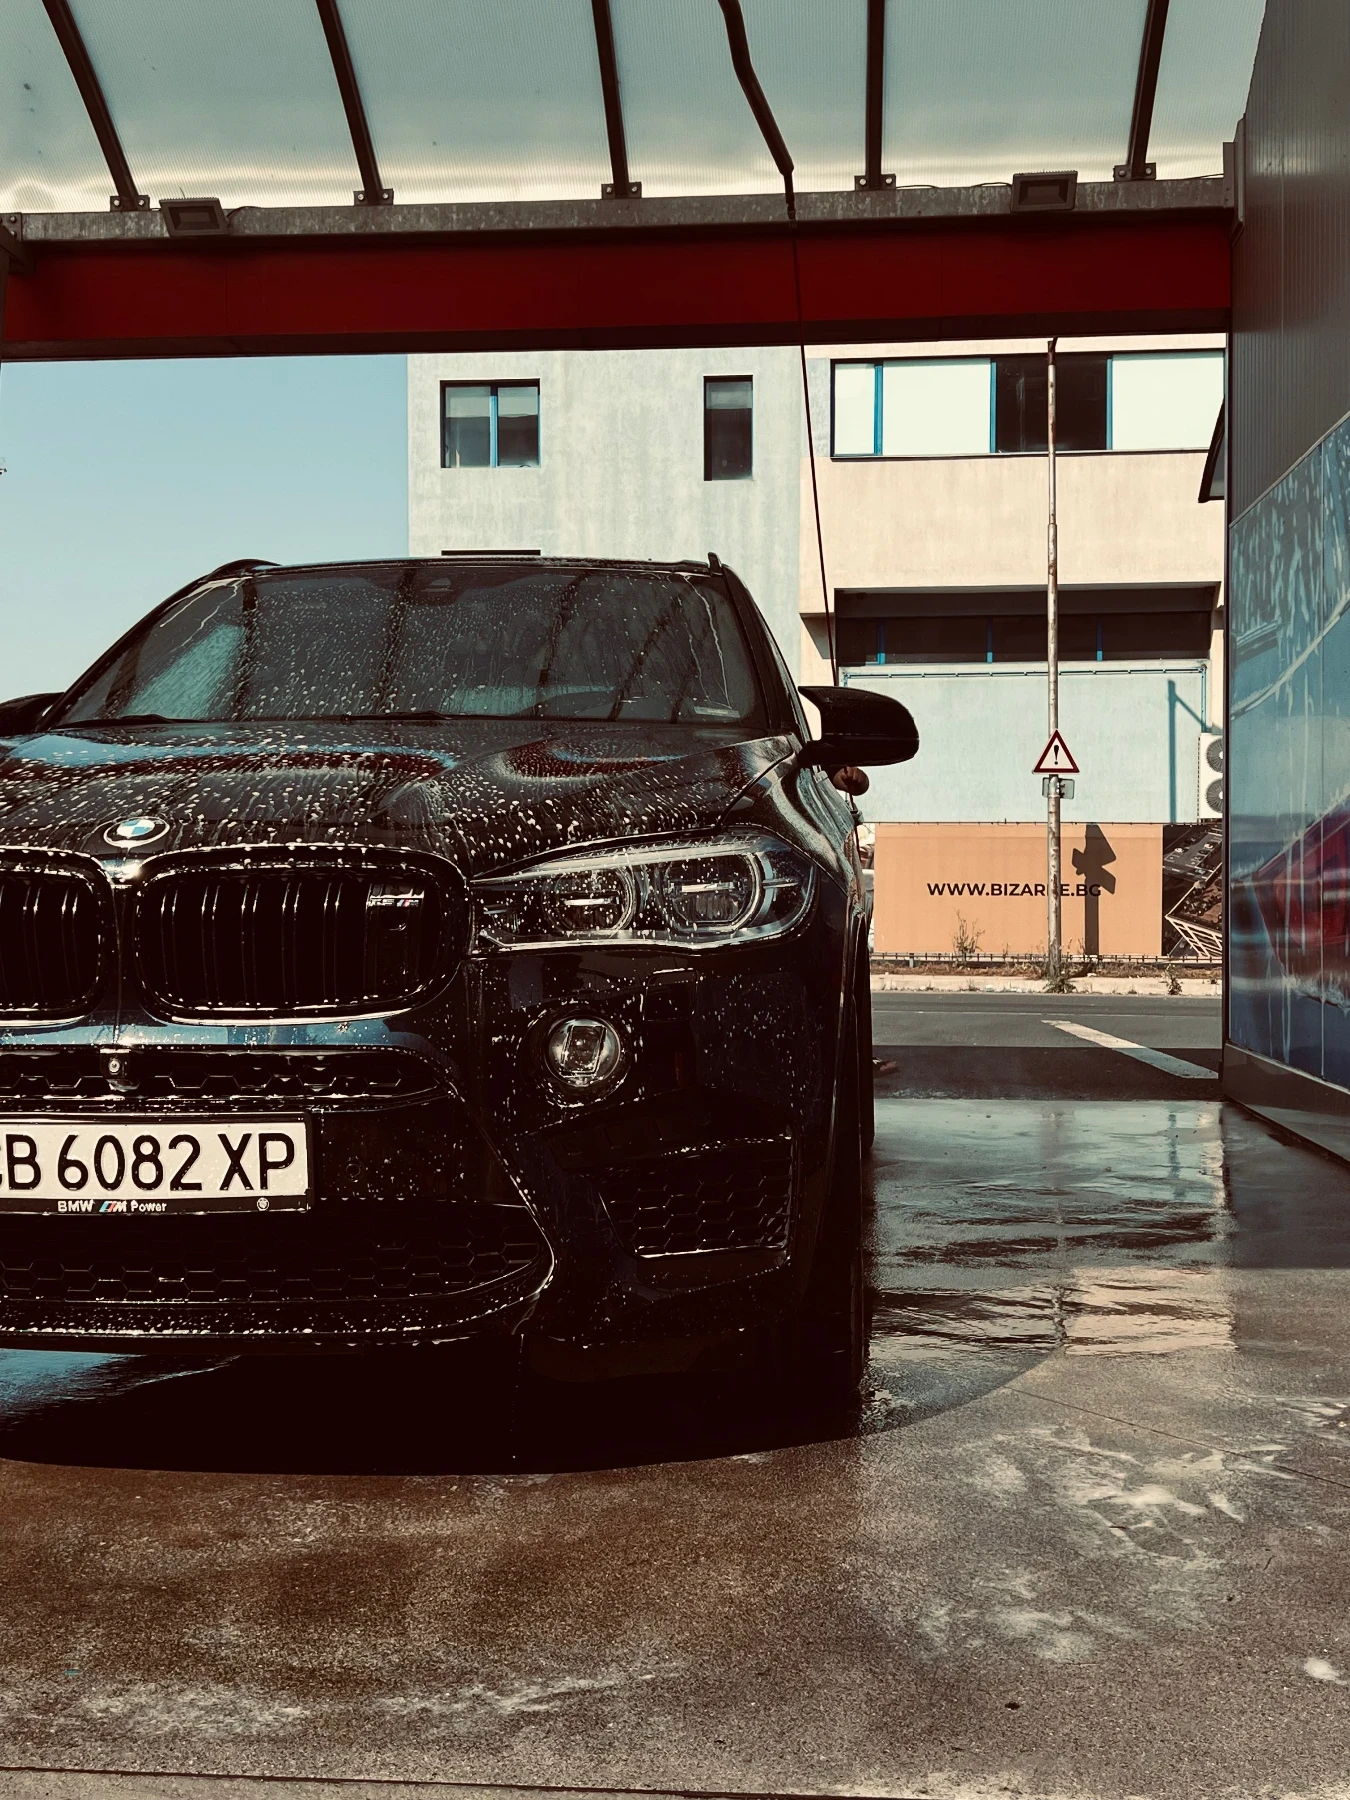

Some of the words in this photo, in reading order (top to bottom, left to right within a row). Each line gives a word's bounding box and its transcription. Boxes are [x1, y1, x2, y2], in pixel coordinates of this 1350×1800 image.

[927, 883, 1102, 897] WWW.BIZARE.BG
[0, 1134, 42, 1191] B
[57, 1134, 203, 1191] 6082
[217, 1132, 295, 1191] XP
[57, 1200, 94, 1212] BMW
[130, 1199, 168, 1212] Power
